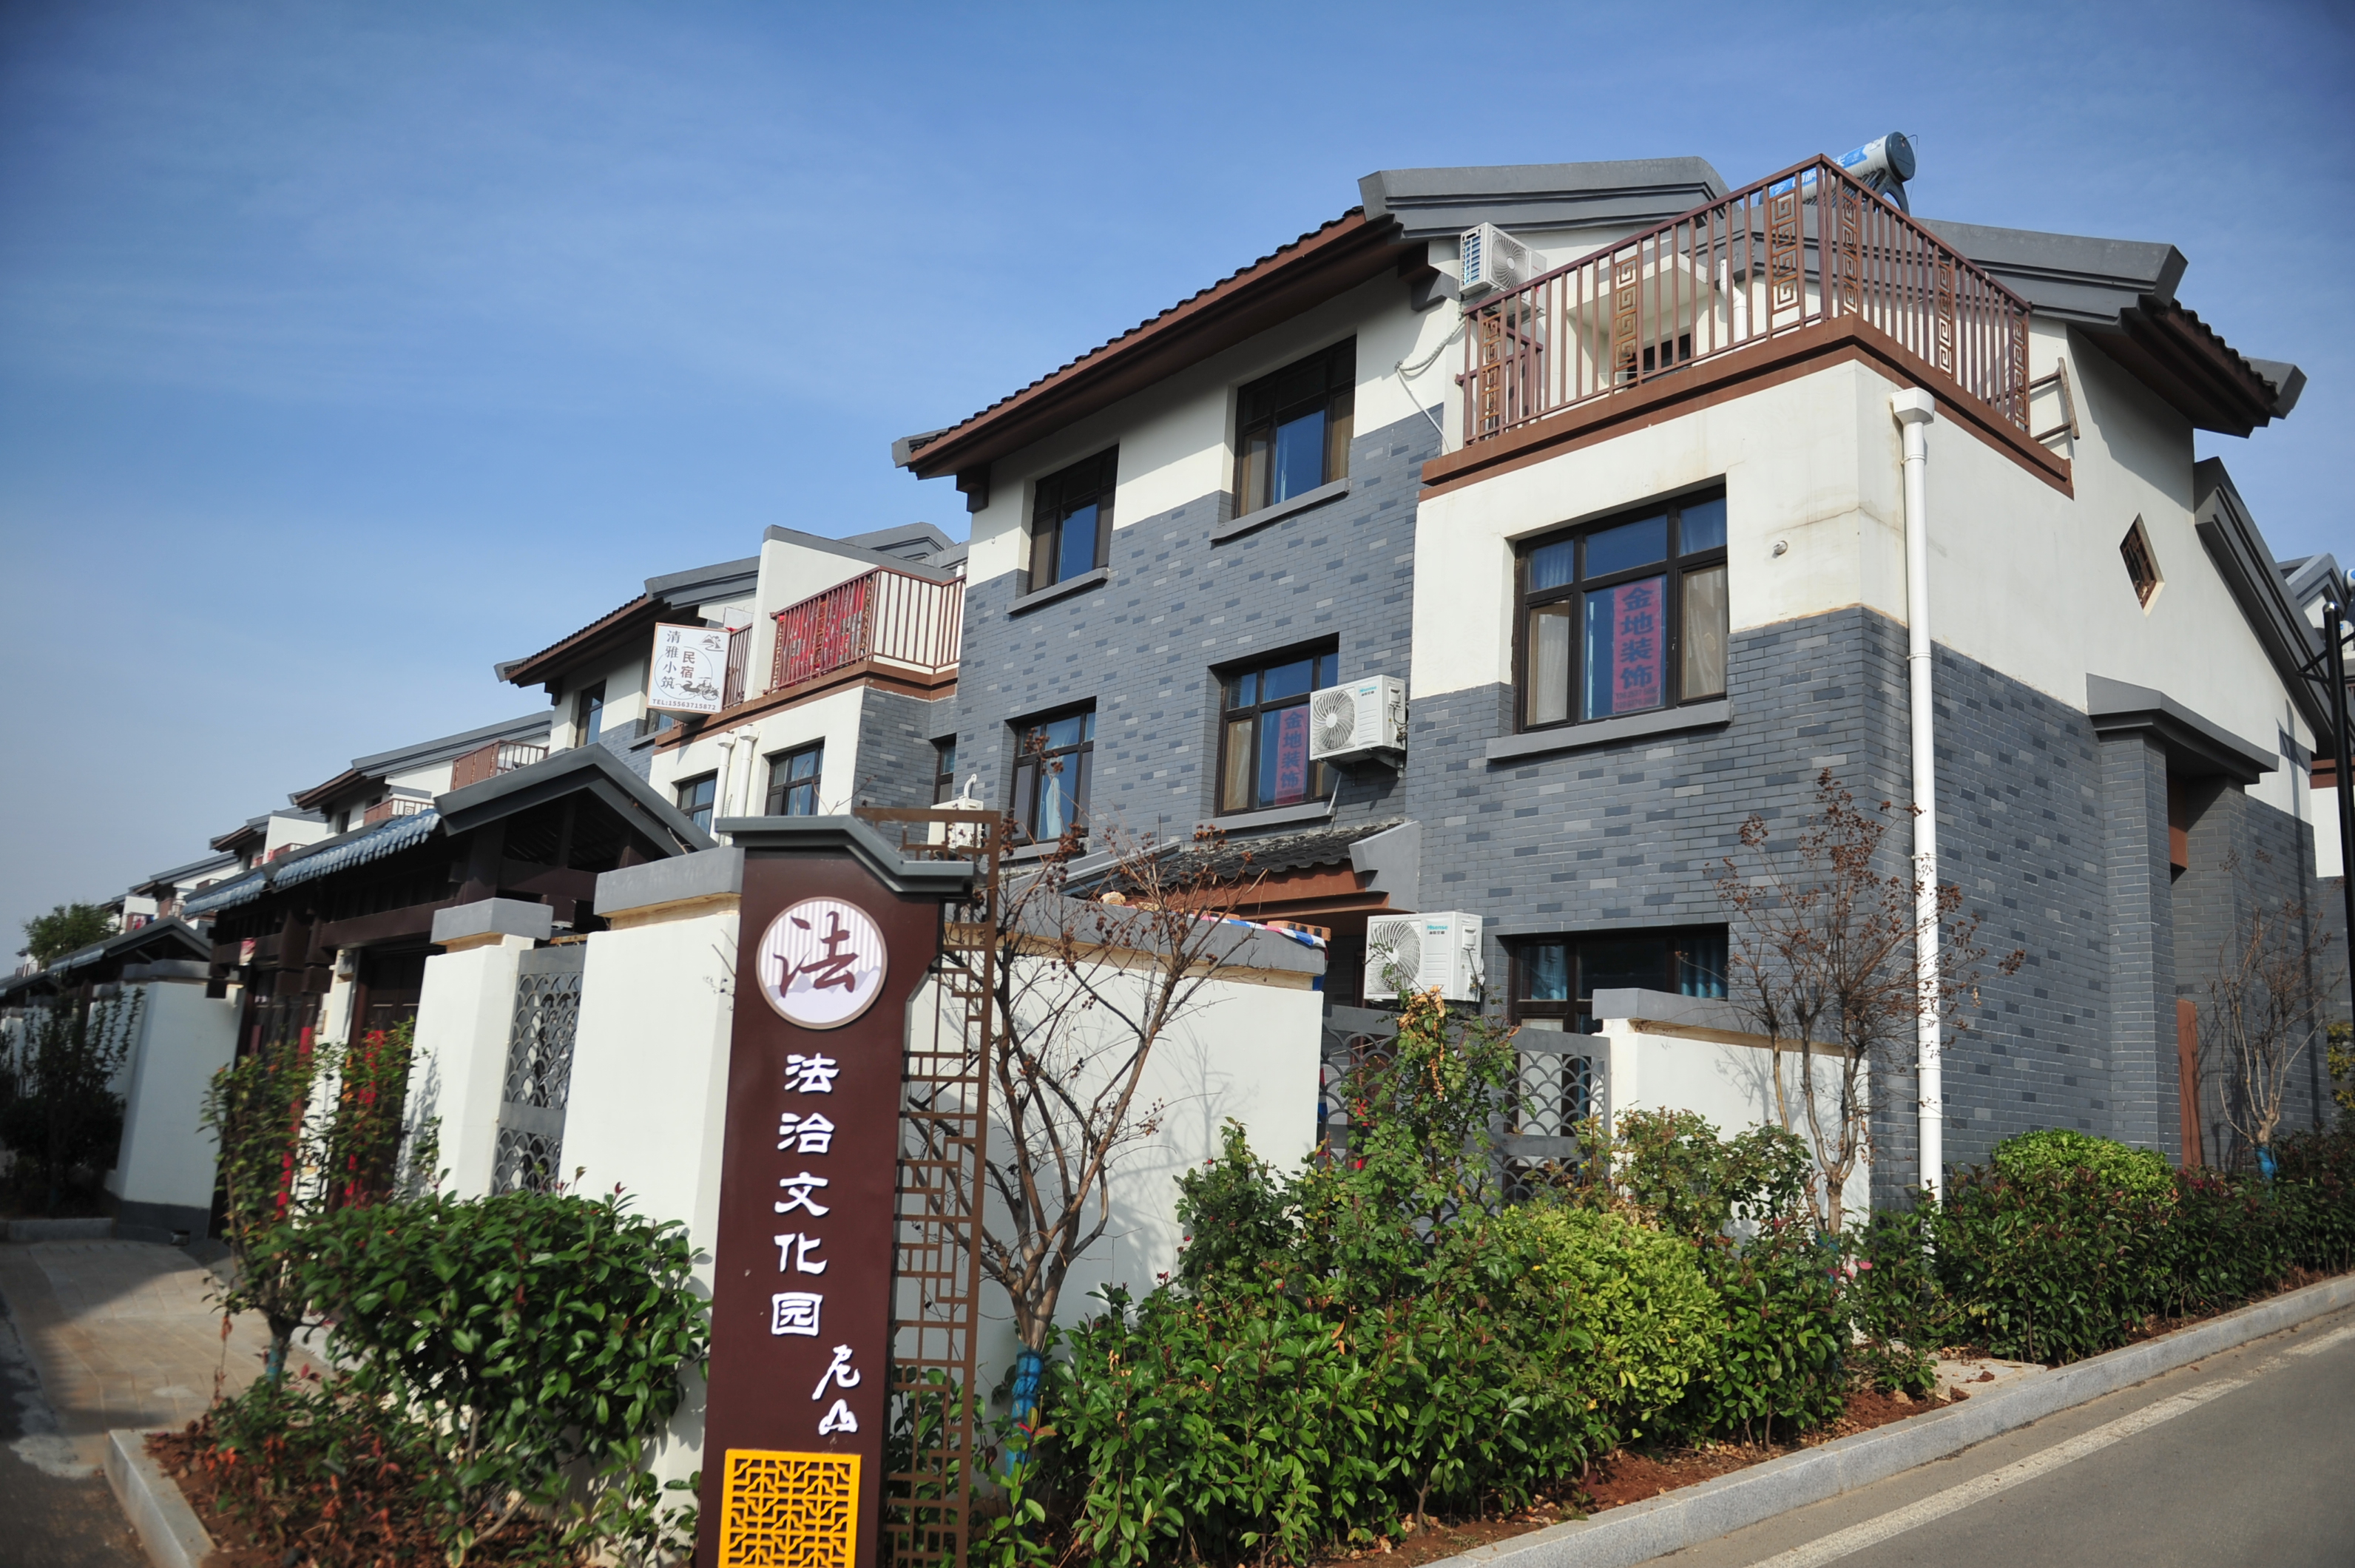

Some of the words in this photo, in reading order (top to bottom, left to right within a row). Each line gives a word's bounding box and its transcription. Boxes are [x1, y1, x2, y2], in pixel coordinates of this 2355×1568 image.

[660, 630, 681, 689] 清雅小筑
[679, 651, 695, 679] 民宿
[1620, 587, 1654, 689] 金地装饰
[1280, 712, 1304, 789] 金地装饰
[773, 910, 859, 998] 法
[771, 1052, 840, 1336] 法治文化园
[811, 1344, 861, 1436] 尼山
